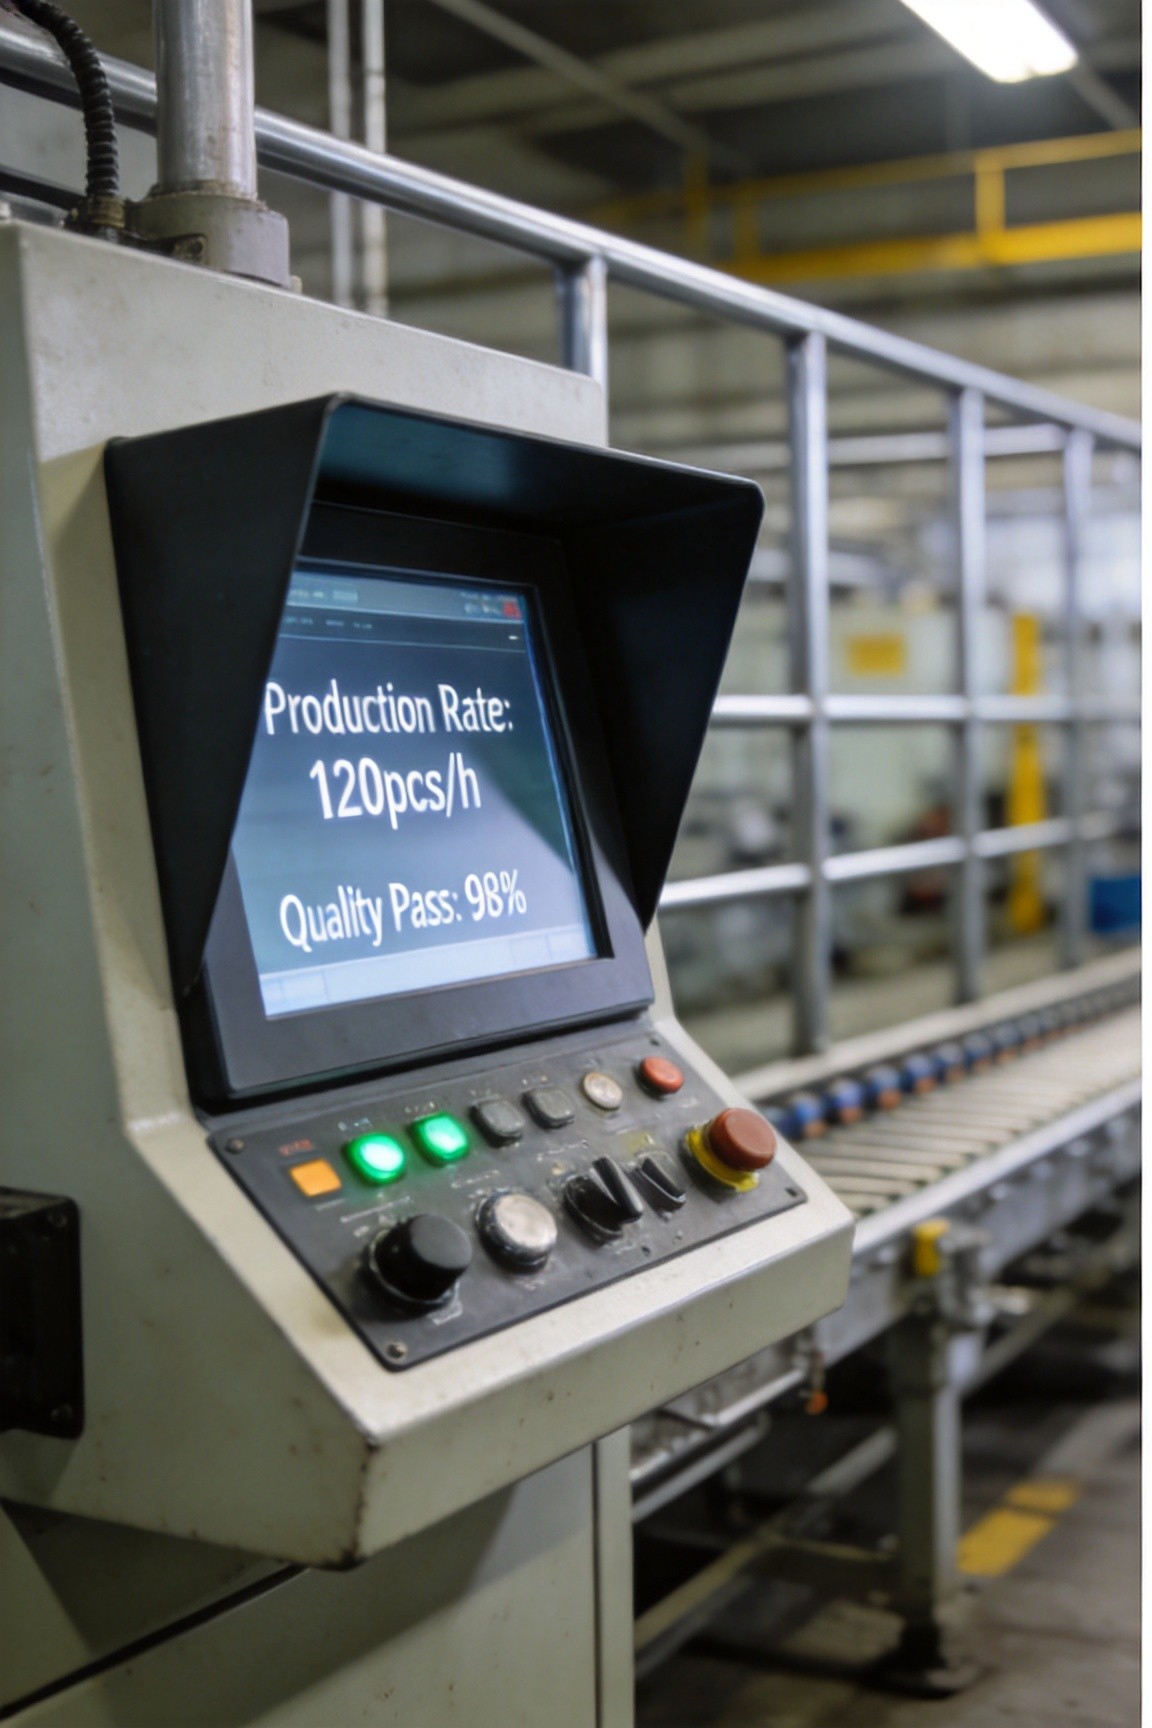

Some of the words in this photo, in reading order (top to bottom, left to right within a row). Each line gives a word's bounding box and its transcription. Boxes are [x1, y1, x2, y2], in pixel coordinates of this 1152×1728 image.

[264, 679, 434, 734] Production
[438, 684, 513, 732] Rate:
[309, 752, 481, 830] 120pcs/h
[279, 885, 382, 952] Quality
[387, 882, 463, 932] Pass:
[464, 869, 527, 922] 98%
